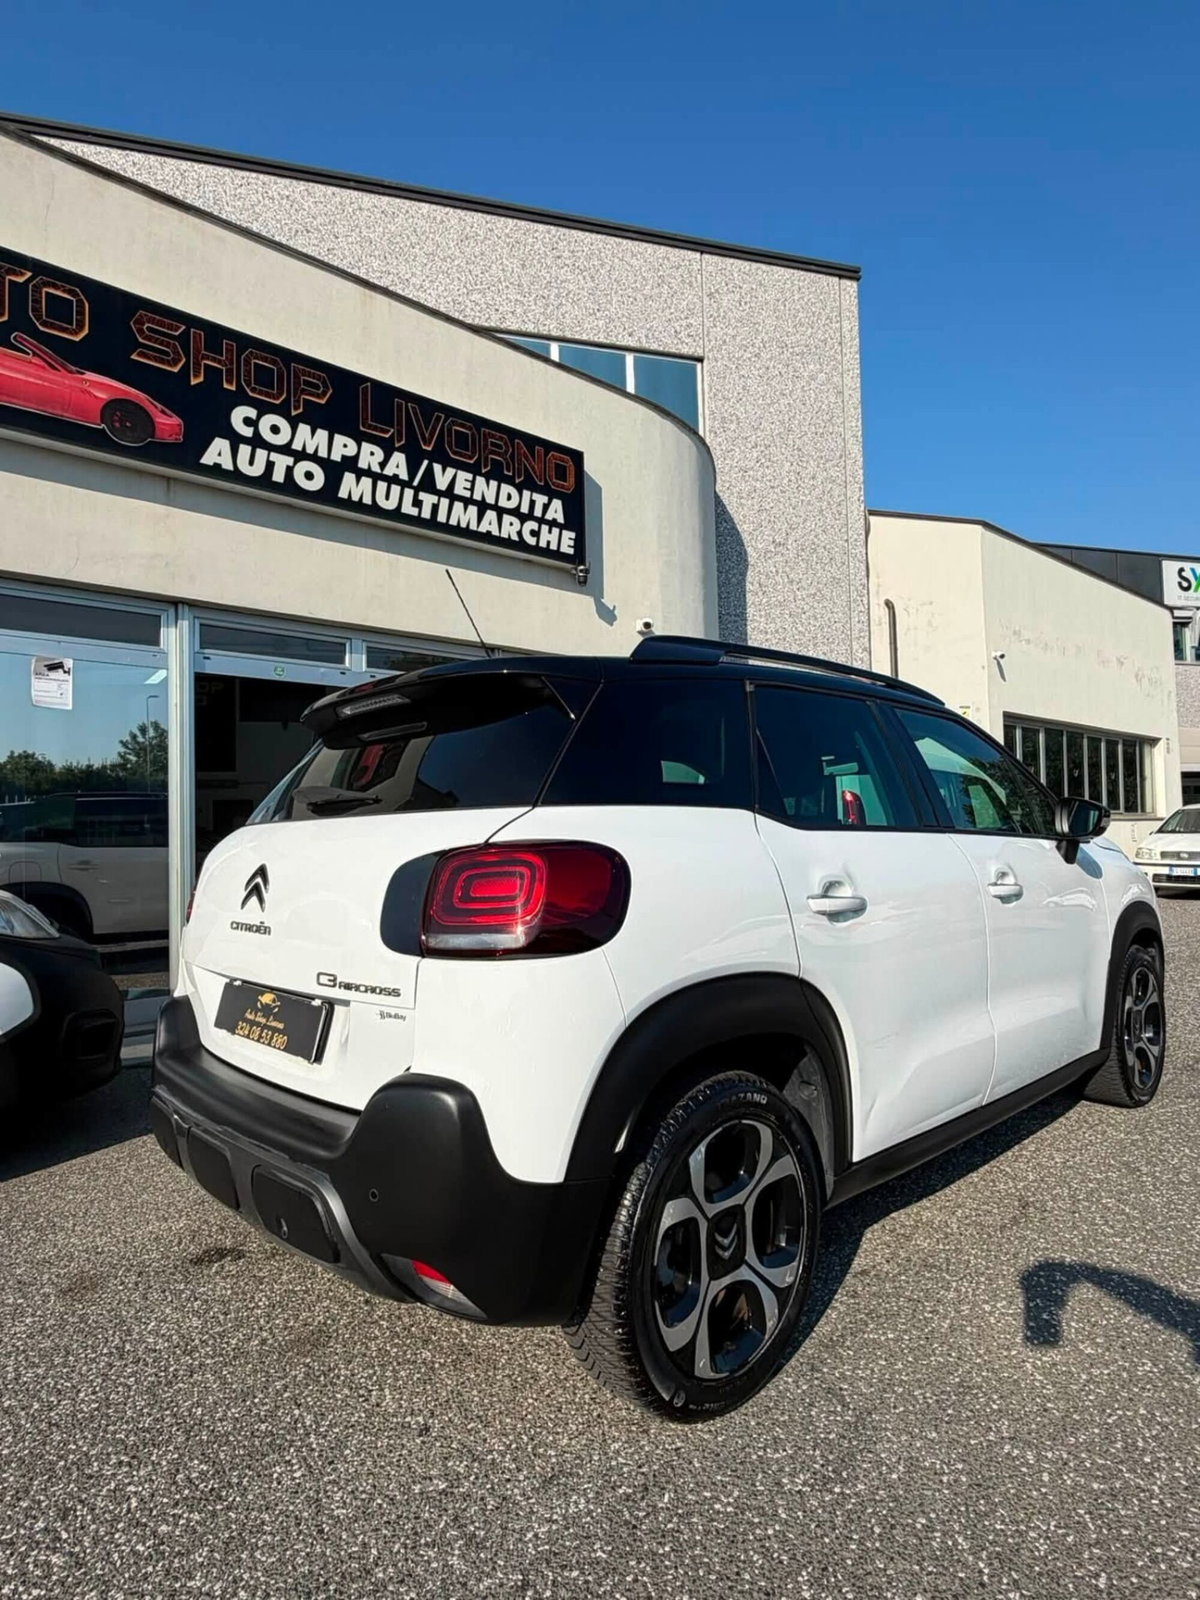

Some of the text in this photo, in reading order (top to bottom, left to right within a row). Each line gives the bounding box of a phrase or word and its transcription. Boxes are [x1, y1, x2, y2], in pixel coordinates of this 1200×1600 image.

[130, 310, 332, 416] SHOP
[360, 382, 577, 493] LIVORNO
[200, 437, 577, 556] AUTO MULTIMARCHE
[230, 405, 566, 524] COMPRA/VENDITA
[230, 921, 271, 936] CITROËN
[316, 972, 402, 997] C3 AIRCROSS
